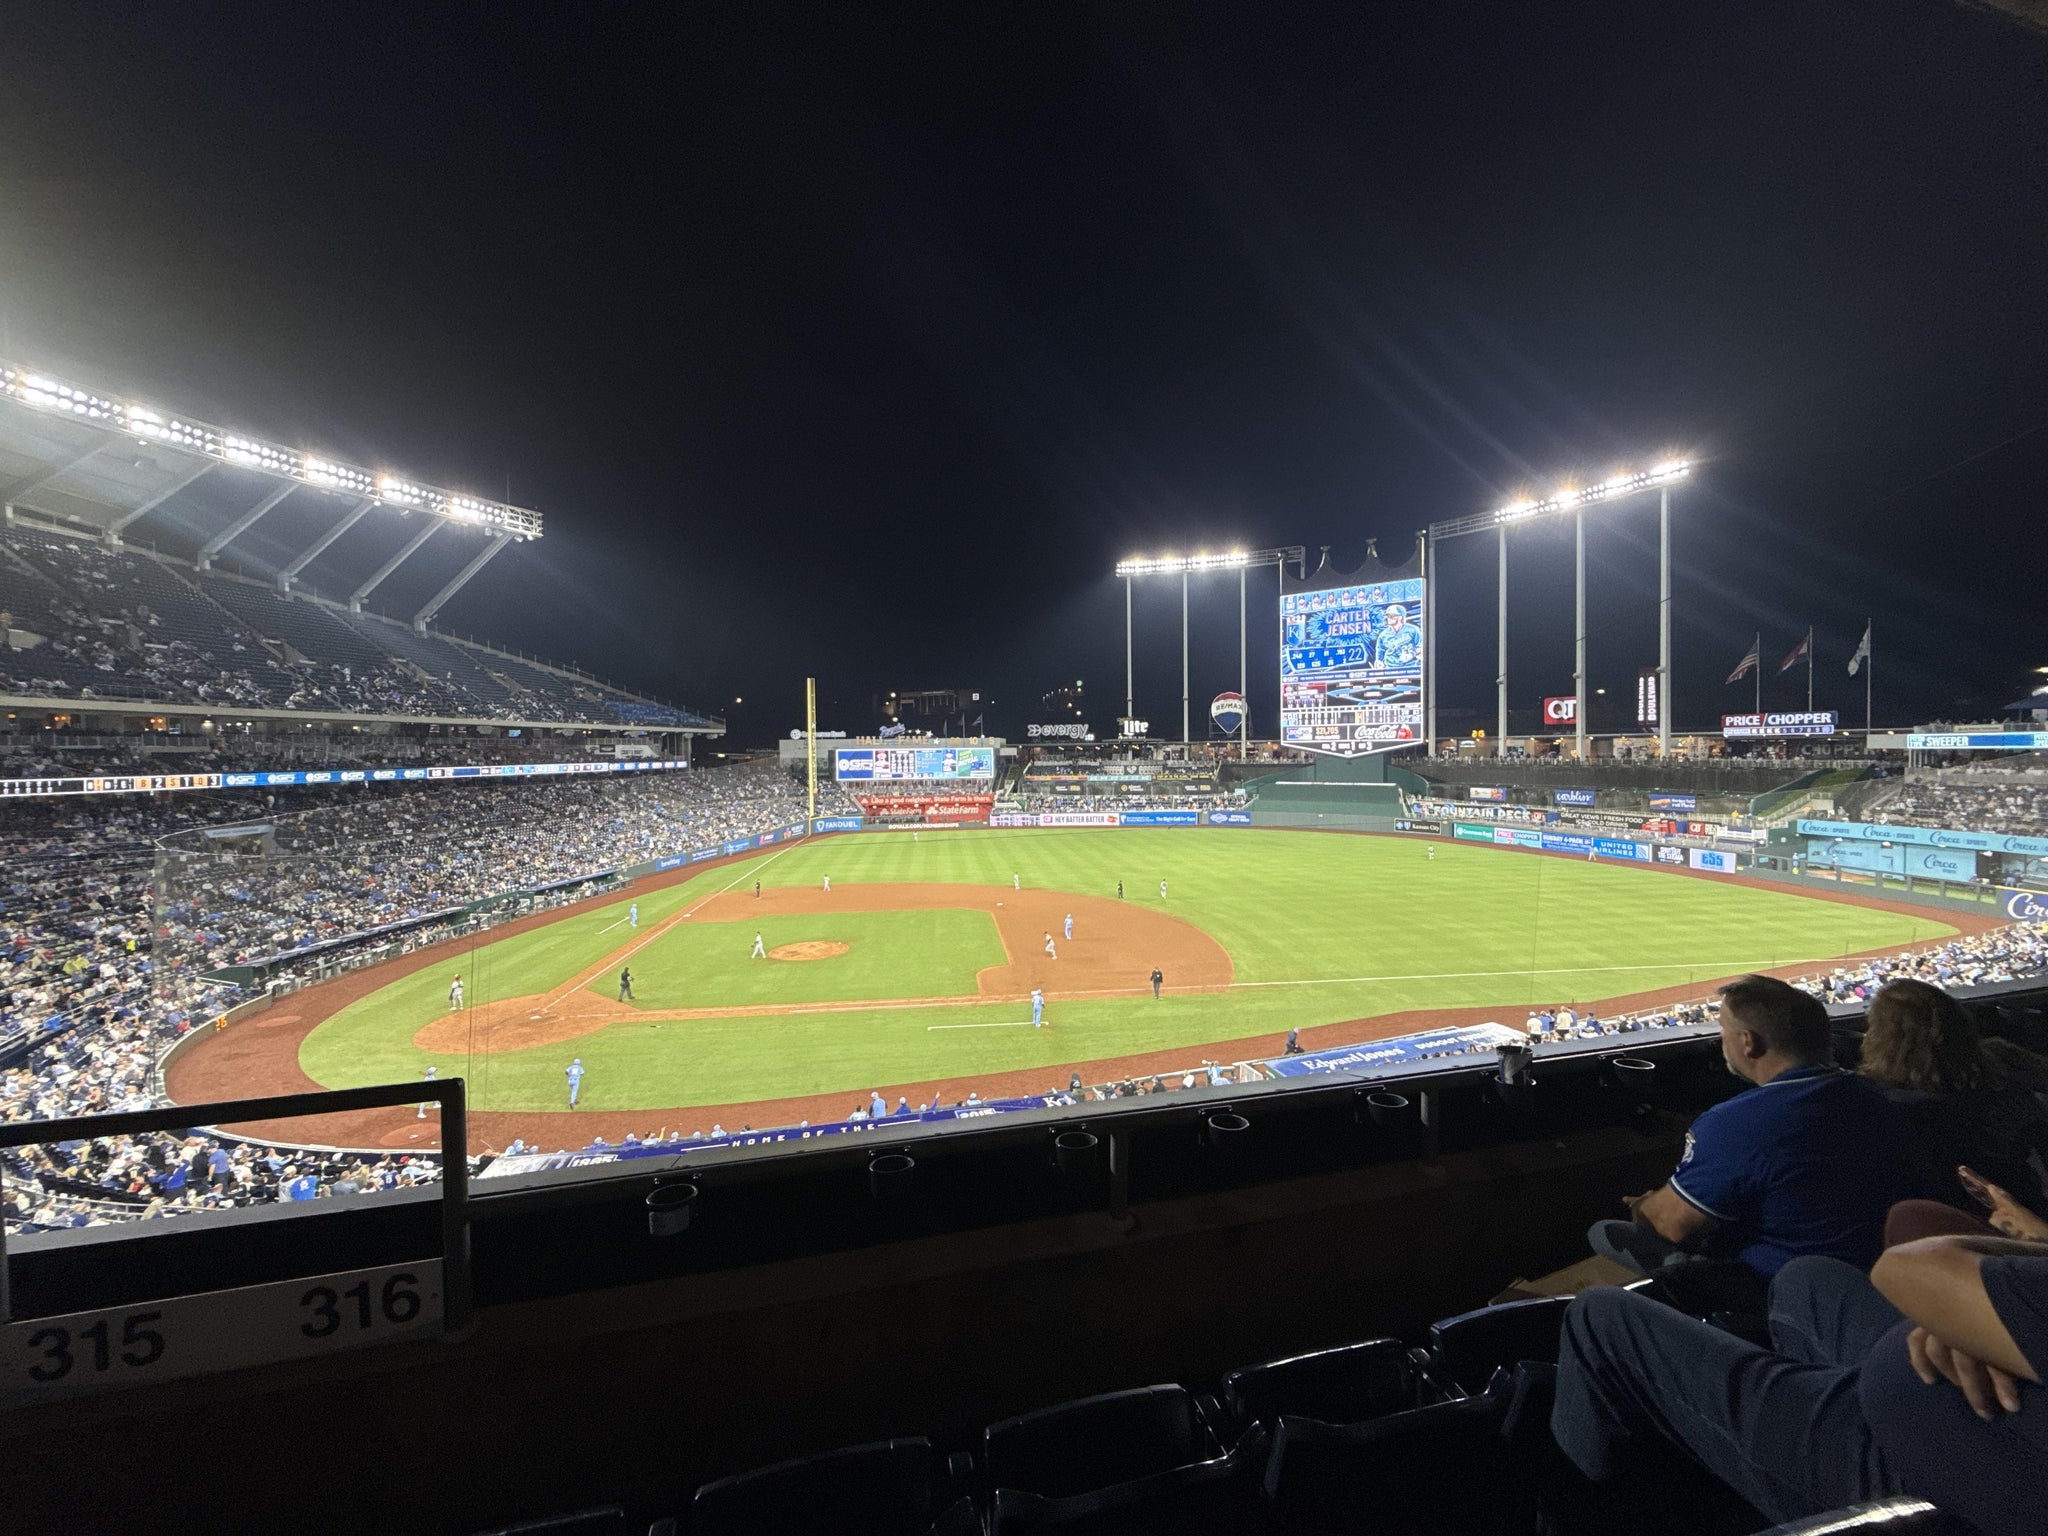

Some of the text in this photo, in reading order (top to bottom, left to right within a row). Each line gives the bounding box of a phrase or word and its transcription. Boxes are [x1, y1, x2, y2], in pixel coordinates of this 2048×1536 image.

[1326, 610, 1370, 624] CARTER
[1326, 622, 1372, 636] JENSEN
[1348, 648, 1362, 661] 22
[1648, 676, 1656, 720] BOULEVARD
[1548, 700, 1576, 719] QT
[1726, 713, 1831, 726] PRICE CHOPPER
[1041, 724, 1088, 738] evergy
[1124, 720, 1149, 735] Lite
[856, 736, 929, 744] HALL FAME
[1331, 742, 1336, 750] 2
[1351, 742, 1355, 750] 1
[1367, 742, 1372, 750] 3
[1927, 736, 1968, 746] SWEEPER
[155, 779, 162, 788] 2
[170, 778, 176, 786] S
[184, 777, 189, 786] 1
[210, 776, 218, 786] 3
[1556, 790, 1592, 802] carbliss
[939, 806, 979, 815] StateFarm
[1433, 805, 1531, 820] FOUNTAIN DECK
[1802, 821, 1828, 832] Circa
[1862, 826, 1891, 838] Circa
[1929, 831, 1962, 844] Circa
[2004, 837, 2038, 851] Circa
[1594, 847, 1633, 856] AIRLINES
[1601, 842, 1633, 850] UNITED
[1924, 854, 1958, 870] Circa
[732, 1123, 874, 1147] HOME OF THE
[300, 1272, 422, 1338] 316
[28, 1310, 165, 1382] 315
